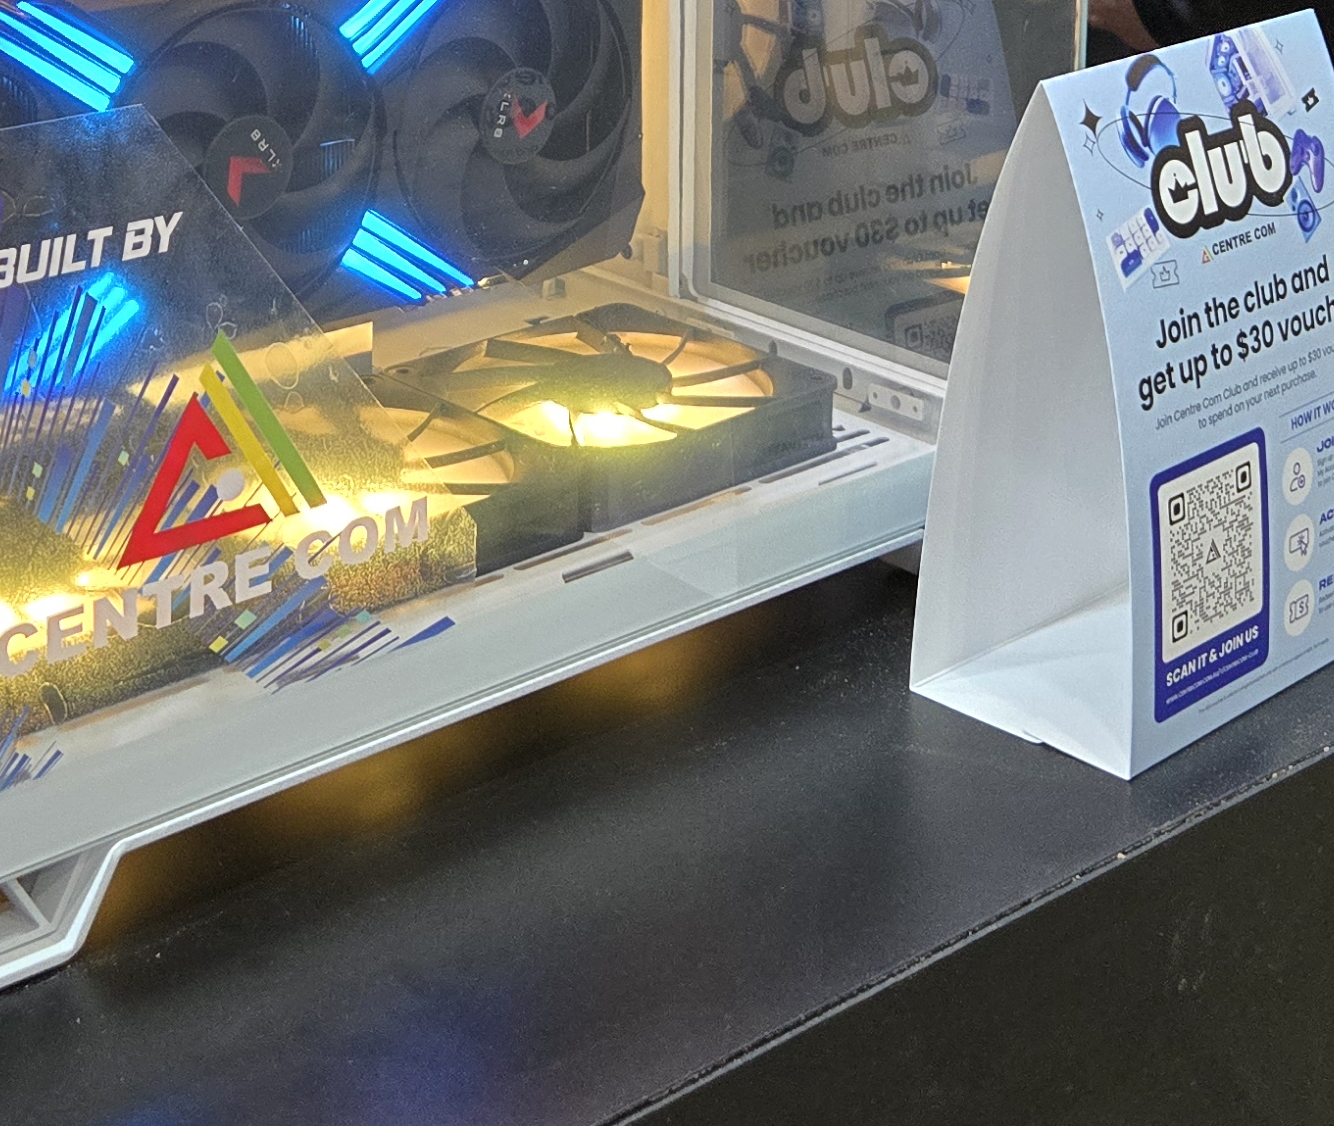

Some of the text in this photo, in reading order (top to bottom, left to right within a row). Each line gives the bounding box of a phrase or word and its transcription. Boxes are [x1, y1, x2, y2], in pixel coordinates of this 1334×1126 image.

[1158, 113, 1285, 225] club
[122, 209, 185, 255] BY
[1211, 221, 1277, 257] CENTRE COM
[1155, 253, 1331, 350] Join the club and
[1138, 362, 1177, 412] get
[1179, 352, 1209, 390] up
[1210, 343, 1233, 370] to
[1236, 319, 1275, 363] $30
[1155, 413, 1173, 431] Join
[1173, 404, 1202, 423] Centre
[1202, 393, 1223, 411] Com
[1222, 383, 1243, 401] Club
[1243, 375, 1259, 393] and
[1259, 365, 1288, 387] receive
[1288, 360, 1299, 374] up
[1298, 355, 1308, 367] to
[1307, 347, 1323, 365] $30
[1197, 417, 1208, 430] to
[1208, 404, 1234, 427] spend
[1234, 400, 1246, 414] on
[1245, 391, 1263, 413] your
[1263, 382, 1281, 401] next
[1290, 410, 1313, 431] HOW
[1313, 405, 1322, 420] IT
[294, 495, 432, 582] COM
[1165, 624, 1260, 687] SCAN IT & JOIN US
